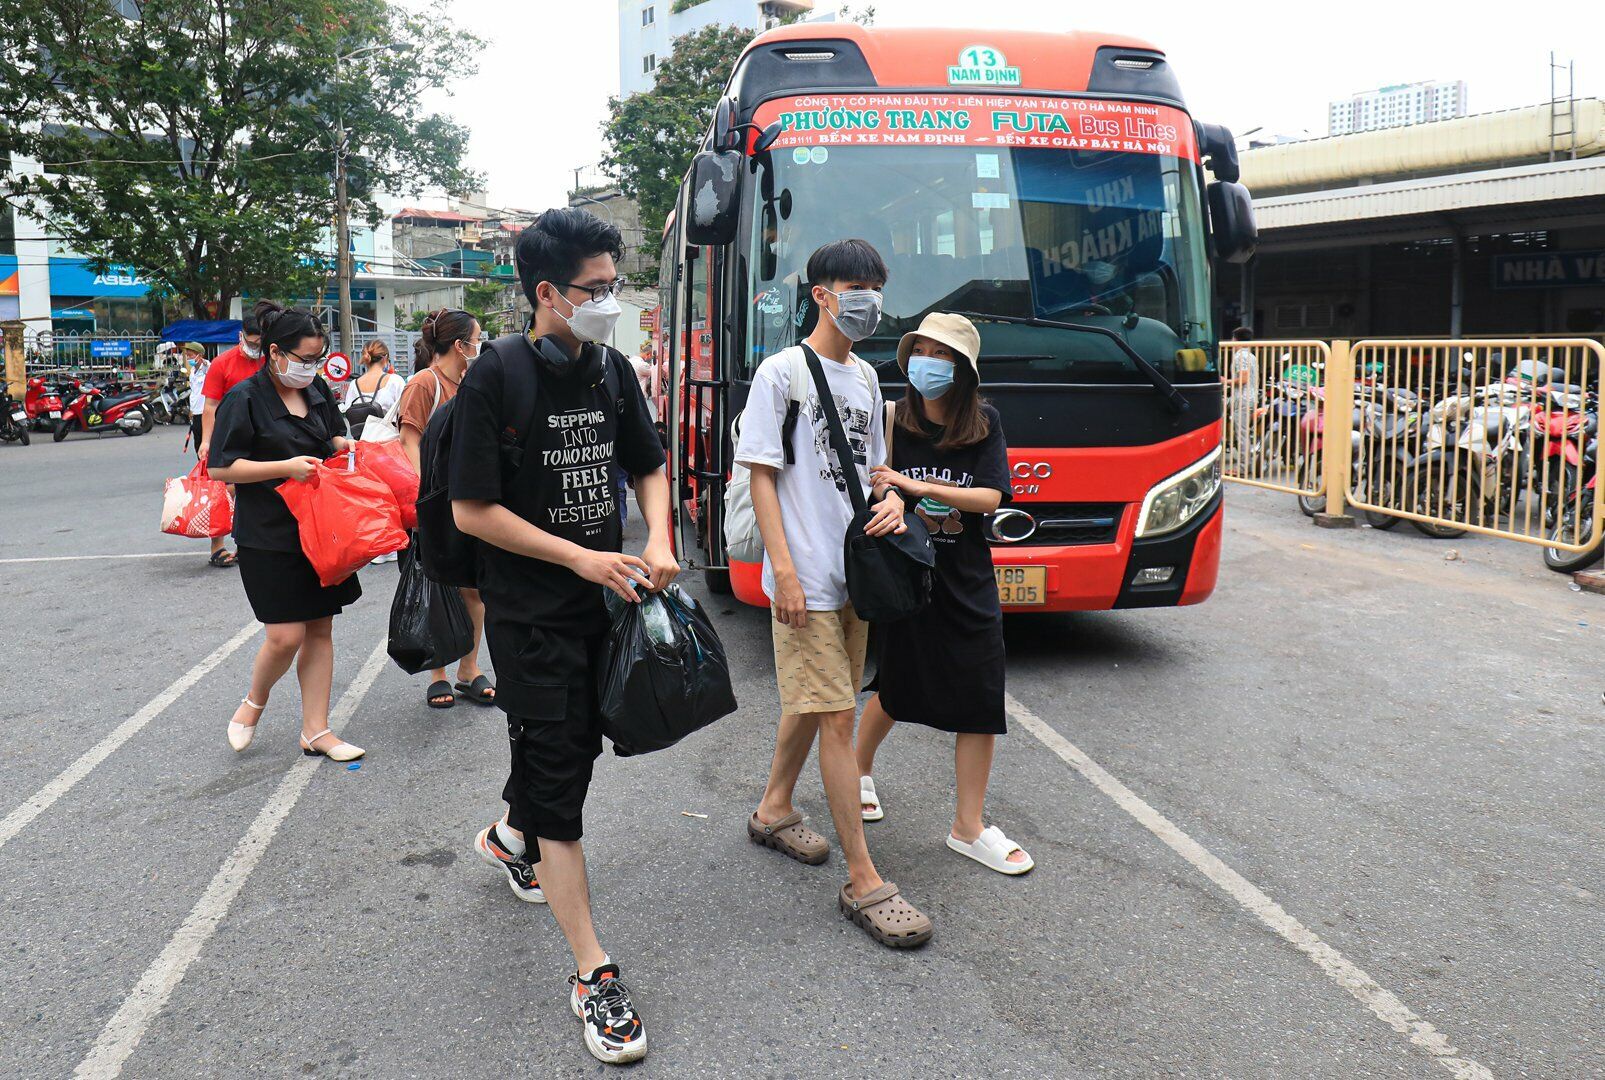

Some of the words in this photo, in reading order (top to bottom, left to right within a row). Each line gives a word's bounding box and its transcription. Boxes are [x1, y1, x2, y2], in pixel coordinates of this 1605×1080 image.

[967, 49, 997, 67] 13
[951, 69, 981, 81] NAM
[985, 69, 1018, 85] ĐỊNH
[795, 96, 829, 107] CÔNG
[832, 97, 846, 107] TY
[957, 96, 983, 107] LIÊN
[985, 98, 1012, 109] HIỆP
[1089, 101, 1106, 112] HÀ
[1107, 104, 1132, 114] NAM
[1133, 106, 1159, 116] NINH
[779, 106, 881, 132] PHƯƠNG
[885, 109, 971, 131] TRANG
[991, 110, 1072, 134] FUTA
[1080, 114, 1120, 137] Bus
[1124, 117, 1177, 142] Lines
[819, 131, 852, 143] BẾN
[856, 134, 880, 143] XE
[882, 134, 920, 143] NAM
[924, 134, 966, 144] ĐỊNH
[996, 132, 1026, 145] BẾN
[1029, 136, 1050, 147] XE
[1052, 136, 1088, 149] GIÁP
[1091, 138, 1120, 149] BÁT
[1123, 140, 1144, 151] HÀ
[1146, 142, 1171, 154] NỘI
[1503, 254, 1566, 281] NHÀ
[93, 274, 146, 287] ABBA
[547, 410, 605, 429] STEPPING
[560, 426, 598, 448] INTO
[562, 465, 609, 490] FEELS
[564, 485, 611, 505] LIKE
[547, 497, 615, 524] YESTERD
[996, 568, 1025, 584] 18B
[1000, 586, 1037, 602] 3.05
